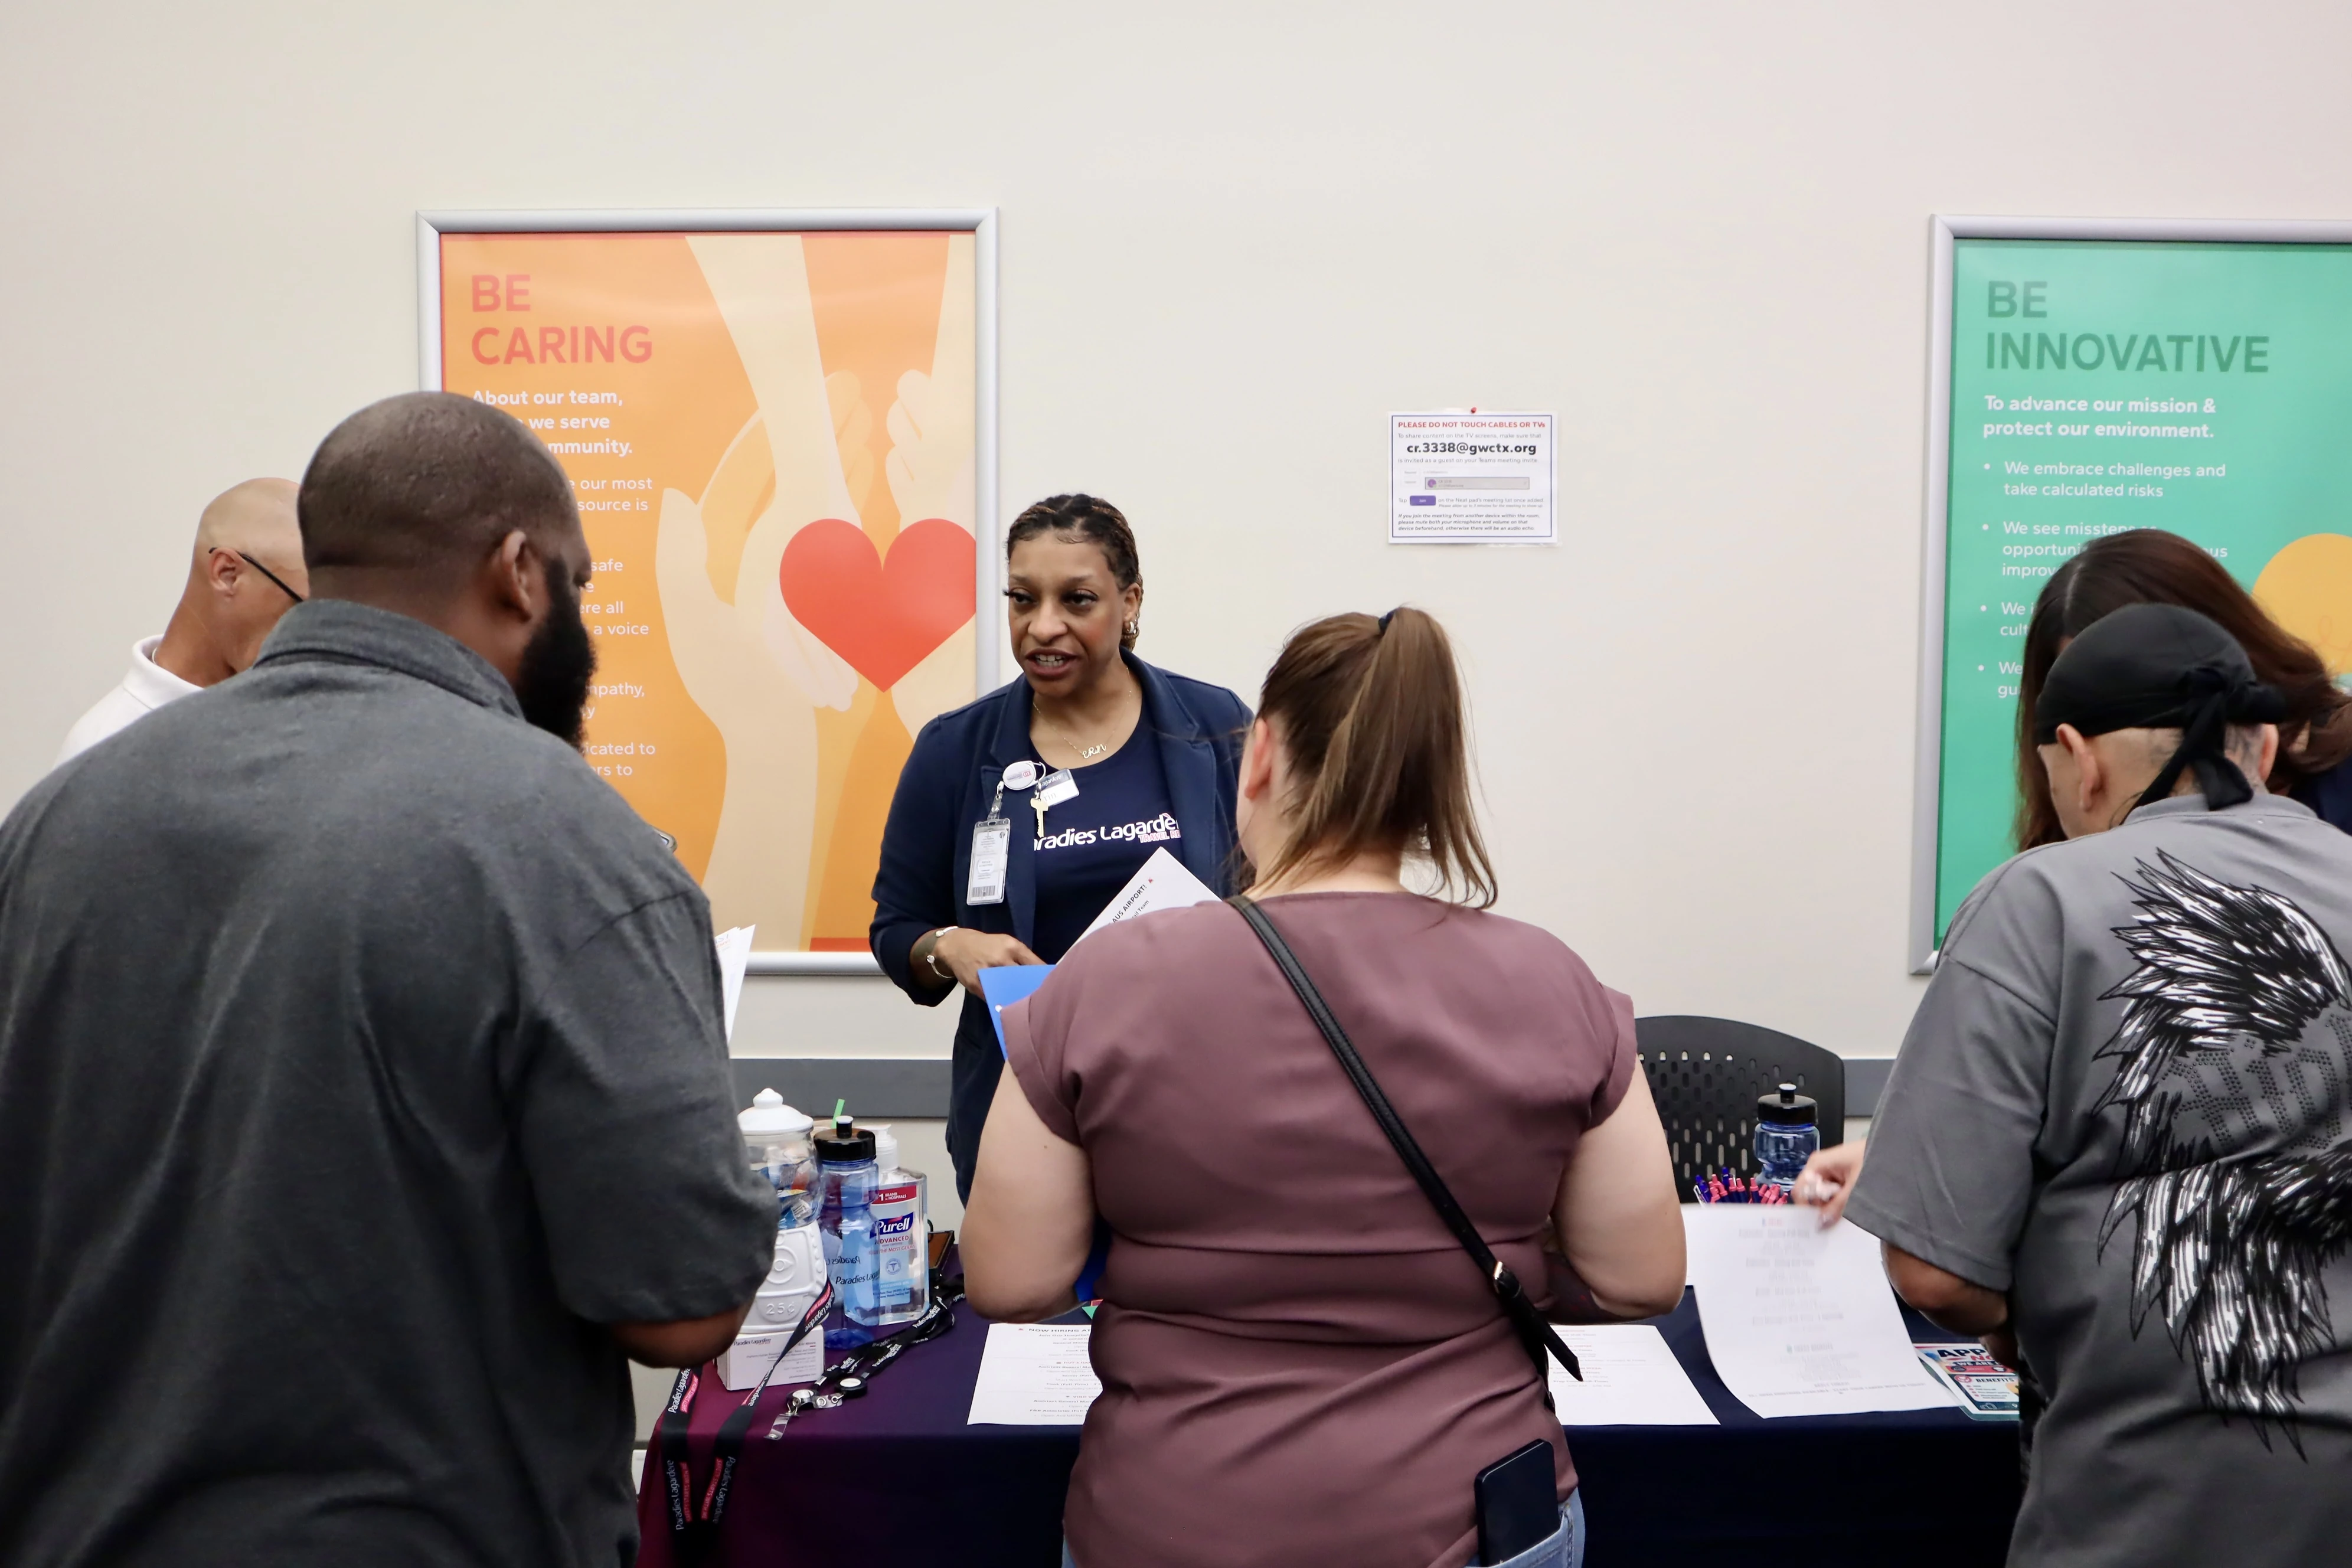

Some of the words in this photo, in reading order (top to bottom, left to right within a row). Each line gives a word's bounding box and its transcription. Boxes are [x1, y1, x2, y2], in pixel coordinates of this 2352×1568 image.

[472, 274, 531, 312] BE
[1988, 280, 2047, 318] BE
[471, 325, 652, 365] CARING
[1987, 332, 2270, 373] INNOVATIVE
[473, 390, 528, 405] About
[533, 393, 564, 404] our
[569, 390, 623, 407] team,
[1984, 395, 2004, 411] To
[2009, 396, 2088, 411] advance
[2093, 401, 2124, 411] our
[2128, 397, 2197, 412] mission
[2203, 398, 2216, 413] &
[528, 417, 554, 429] we
[560, 417, 610, 429] serve
[1984, 421, 2052, 437] protect
[2058, 426, 2089, 436] our
[2095, 422, 2214, 437] environment.
[547, 438, 632, 457] mmunity.
[1407, 442, 1537, 455] cr.3338@gwctx.org
[2005, 462, 2028, 475] We
[2034, 462, 2103, 475] embrace
[2109, 463, 2191, 479] challenges
[2196, 463, 2226, 476] and
[580, 480, 607, 489] our
[612, 478, 652, 489] most
[2004, 483, 2037, 495] take
[2042, 484, 2124, 496] calculated
[2128, 484, 2163, 496] risks
[577, 501, 631, 511] source
[635, 498, 648, 511] is
[2003, 521, 2028, 534] We
[2033, 525, 2060, 535] see
[2003, 544, 2082, 557] opportuni
[591, 558, 623, 571] safe
[2003, 563, 2054, 578] improv
[579, 604, 600, 614] ere
[606, 600, 624, 614] all
[2001, 602, 2026, 615] We
[593, 625, 602, 635] a
[607, 622, 649, 635] voice
[2000, 623, 2028, 636] cult
[1999, 661, 2023, 674] We
[586, 682, 645, 698] mpathy,
[586, 742, 634, 755] icated
[639, 743, 656, 755] to
[616, 764, 633, 776] to
[1044, 792, 1057, 801] rin
[1034, 828, 1097, 851] radies
[1100, 812, 1180, 841] Lagardè
[1138, 831, 1170, 844] TRAVEL
[1112, 910, 1123, 923] AUS
[1123, 884, 1147, 912] AIRPORT!
[1138, 900, 1149, 912] Team
[836, 1275, 865, 1285] Paradies
[1937, 1348, 1986, 1357] APP
[668, 1391, 682, 1413] Paradies
[672, 1498, 684, 1530] Paradies
